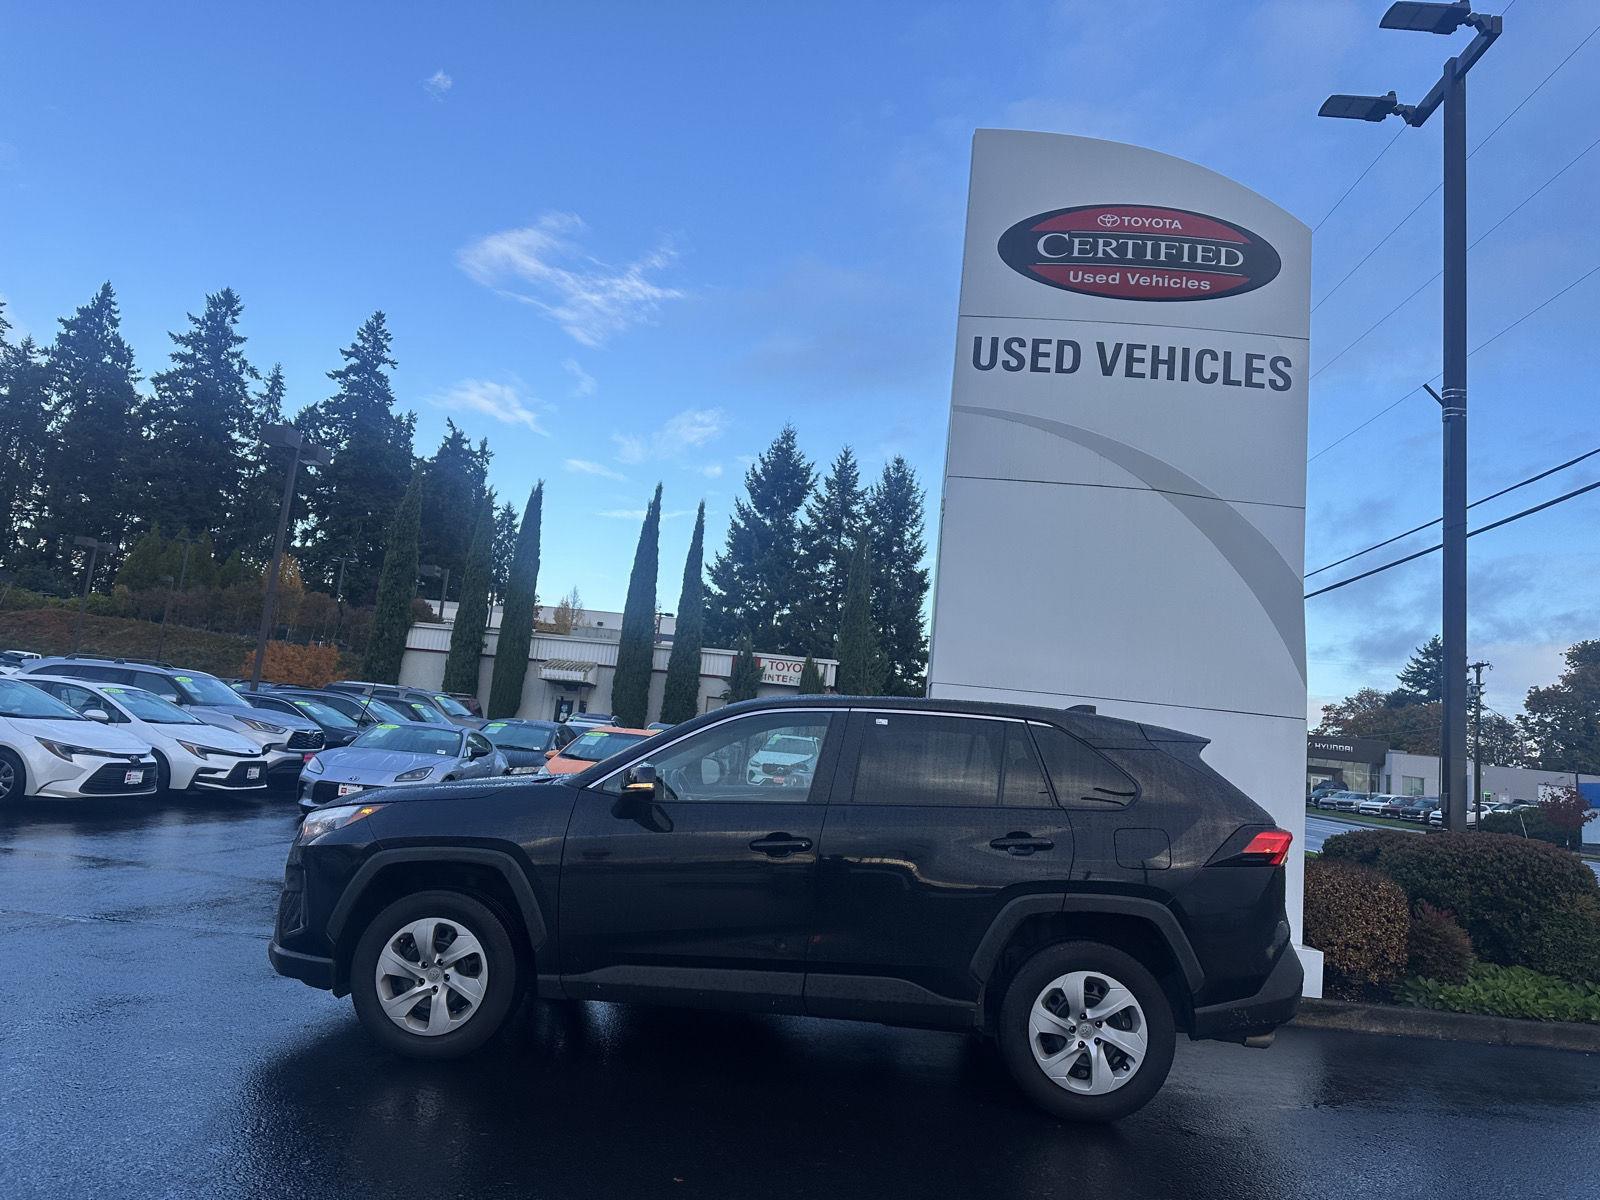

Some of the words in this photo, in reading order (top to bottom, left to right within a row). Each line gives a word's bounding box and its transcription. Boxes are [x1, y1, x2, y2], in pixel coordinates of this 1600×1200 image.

[1121, 216, 1182, 229] TOYOTA
[1037, 232, 1244, 268] CERTIFIED
[1068, 270, 1120, 285] Used
[1127, 273, 1211, 290] Vehicles
[972, 336, 1082, 374] USED
[1096, 341, 1293, 392] VEHICLES
[1314, 742, 1353, 753] HYUNDAI
